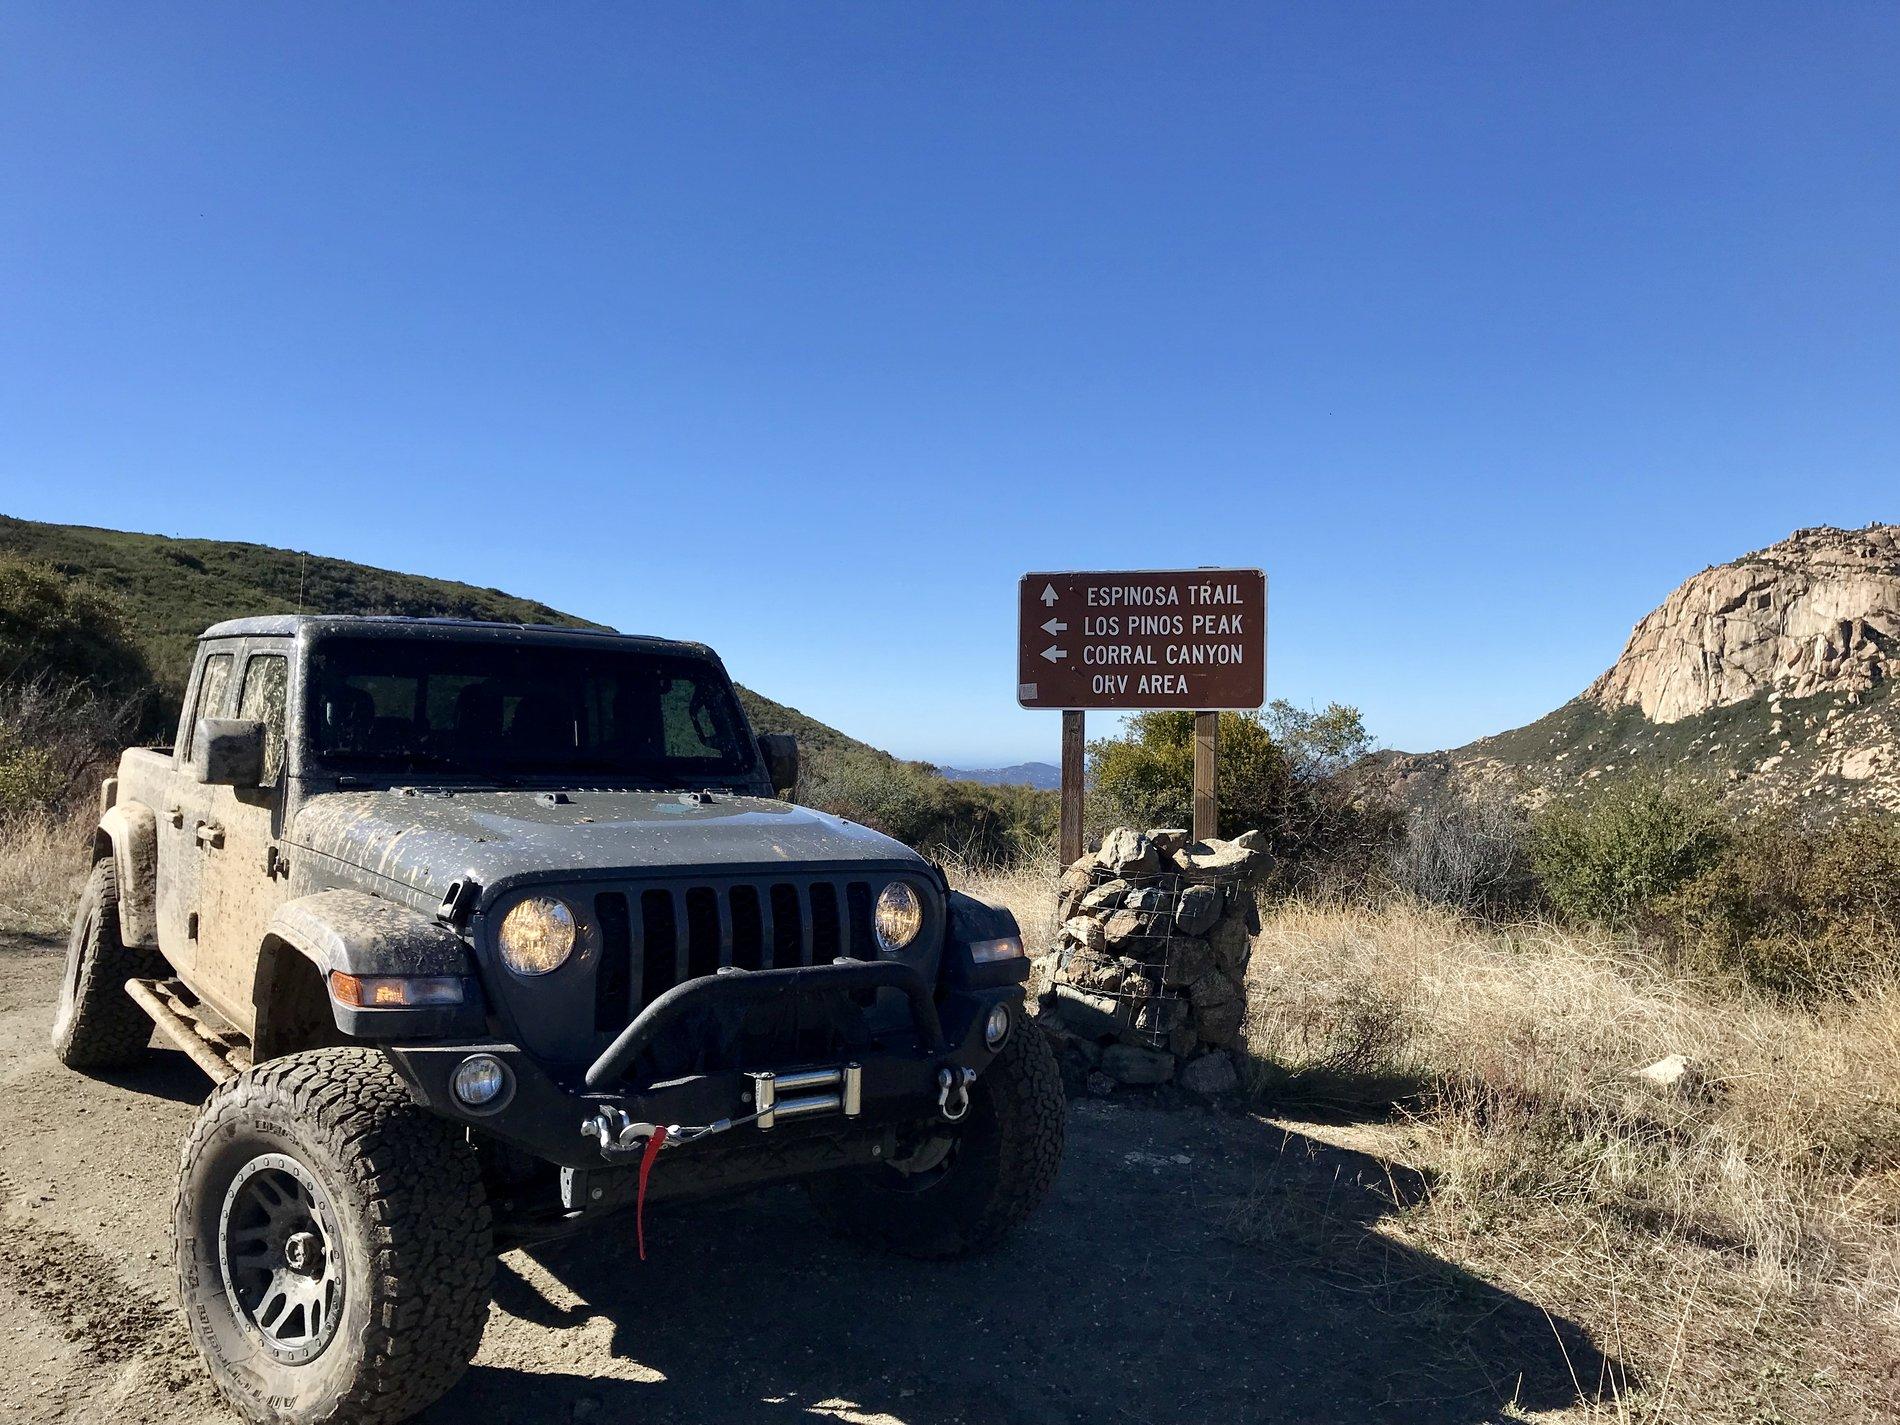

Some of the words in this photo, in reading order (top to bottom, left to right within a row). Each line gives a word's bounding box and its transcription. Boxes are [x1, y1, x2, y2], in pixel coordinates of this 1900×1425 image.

[1087, 585, 1179, 606] ESPINOSA
[1187, 584, 1244, 605] TRAIL
[1084, 616, 1120, 636] LOS
[1128, 615, 1184, 635] PINOS
[1192, 614, 1243, 635] PEAK
[1083, 645, 1158, 665] CORRAL
[1166, 644, 1243, 665] CANYON
[1092, 674, 1129, 694] ORV
[1137, 674, 1189, 694] AREA
